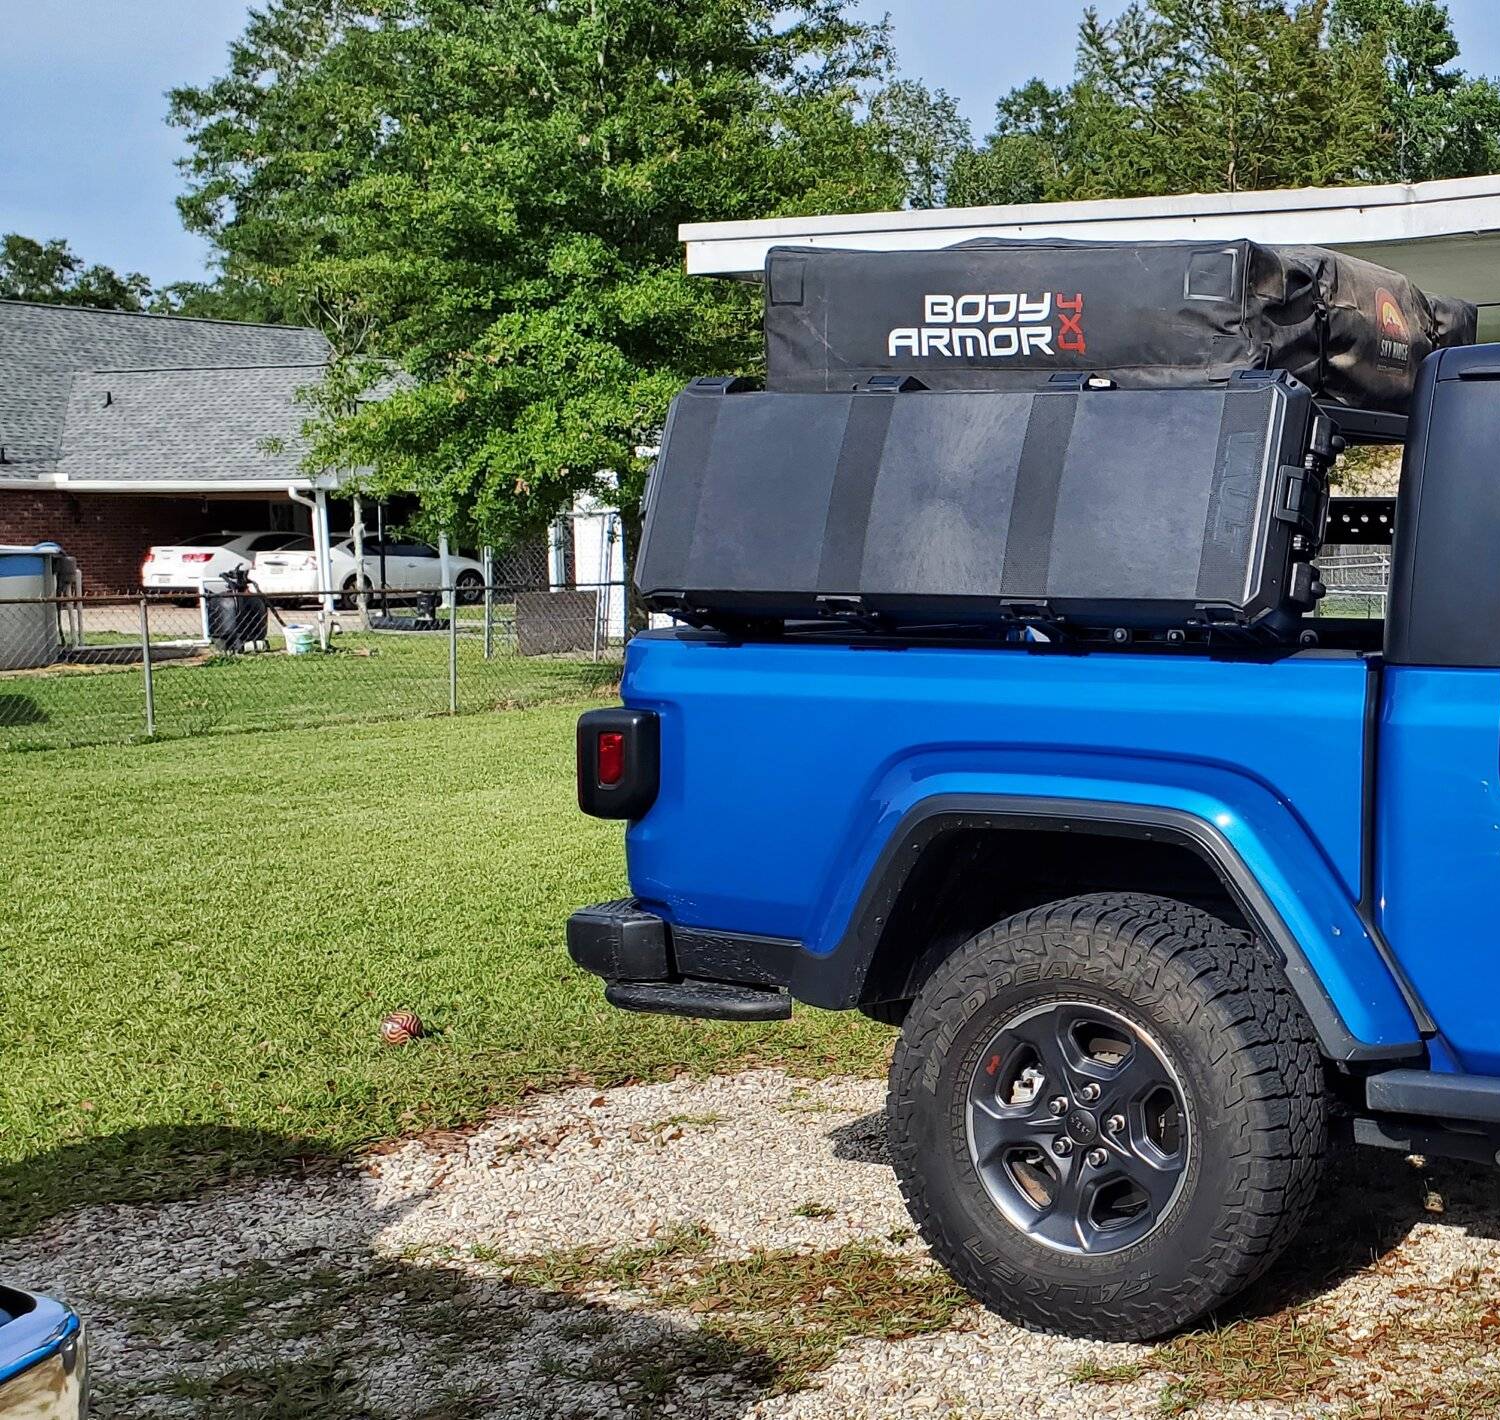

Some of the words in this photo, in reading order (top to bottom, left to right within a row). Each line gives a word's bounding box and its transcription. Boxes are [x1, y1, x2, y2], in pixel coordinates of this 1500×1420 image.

[924, 292, 1052, 323] BODY
[888, 326, 1055, 357] ARMOR
[922, 961, 1104, 1096] WILDPEAK
